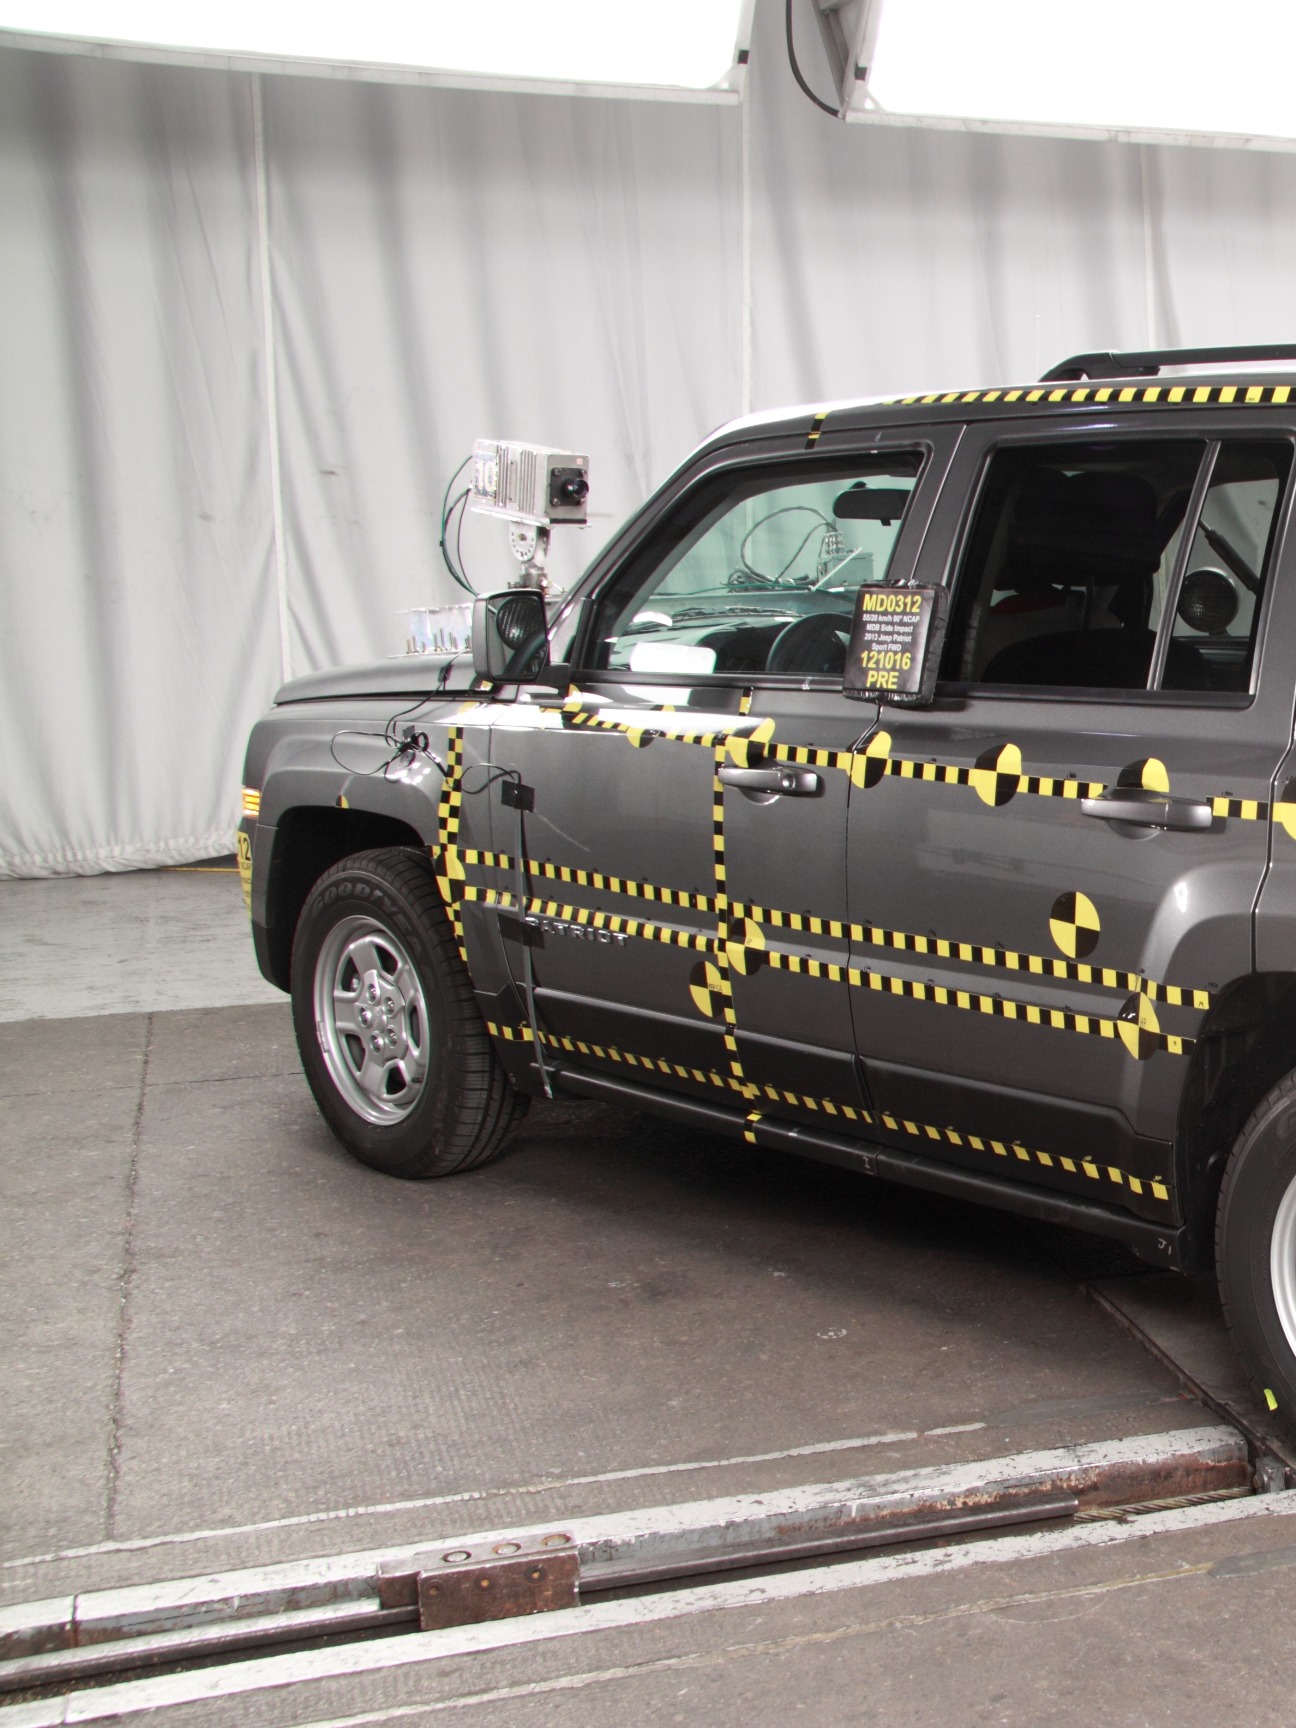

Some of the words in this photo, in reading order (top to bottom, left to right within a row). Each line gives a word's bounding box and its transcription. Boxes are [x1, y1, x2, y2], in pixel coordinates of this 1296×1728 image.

[862, 593, 922, 613] MD0312
[862, 613, 878, 622] 55/28
[878, 614, 893, 622] km/h
[903, 615, 920, 623] NCAP
[866, 623, 880, 631] MDB
[881, 624, 894, 632] Side
[894, 624, 913, 633] Impact
[864, 633, 878, 641] 2013
[878, 634, 893, 642] Jeep
[893, 634, 912, 642] Patriot
[871, 643, 887, 652] Sport
[887, 643, 902, 651] FWD
[861, 650, 911, 670] 121016
[866, 670, 899, 689] PRE
[524, 916, 629, 947] PATRIOT
